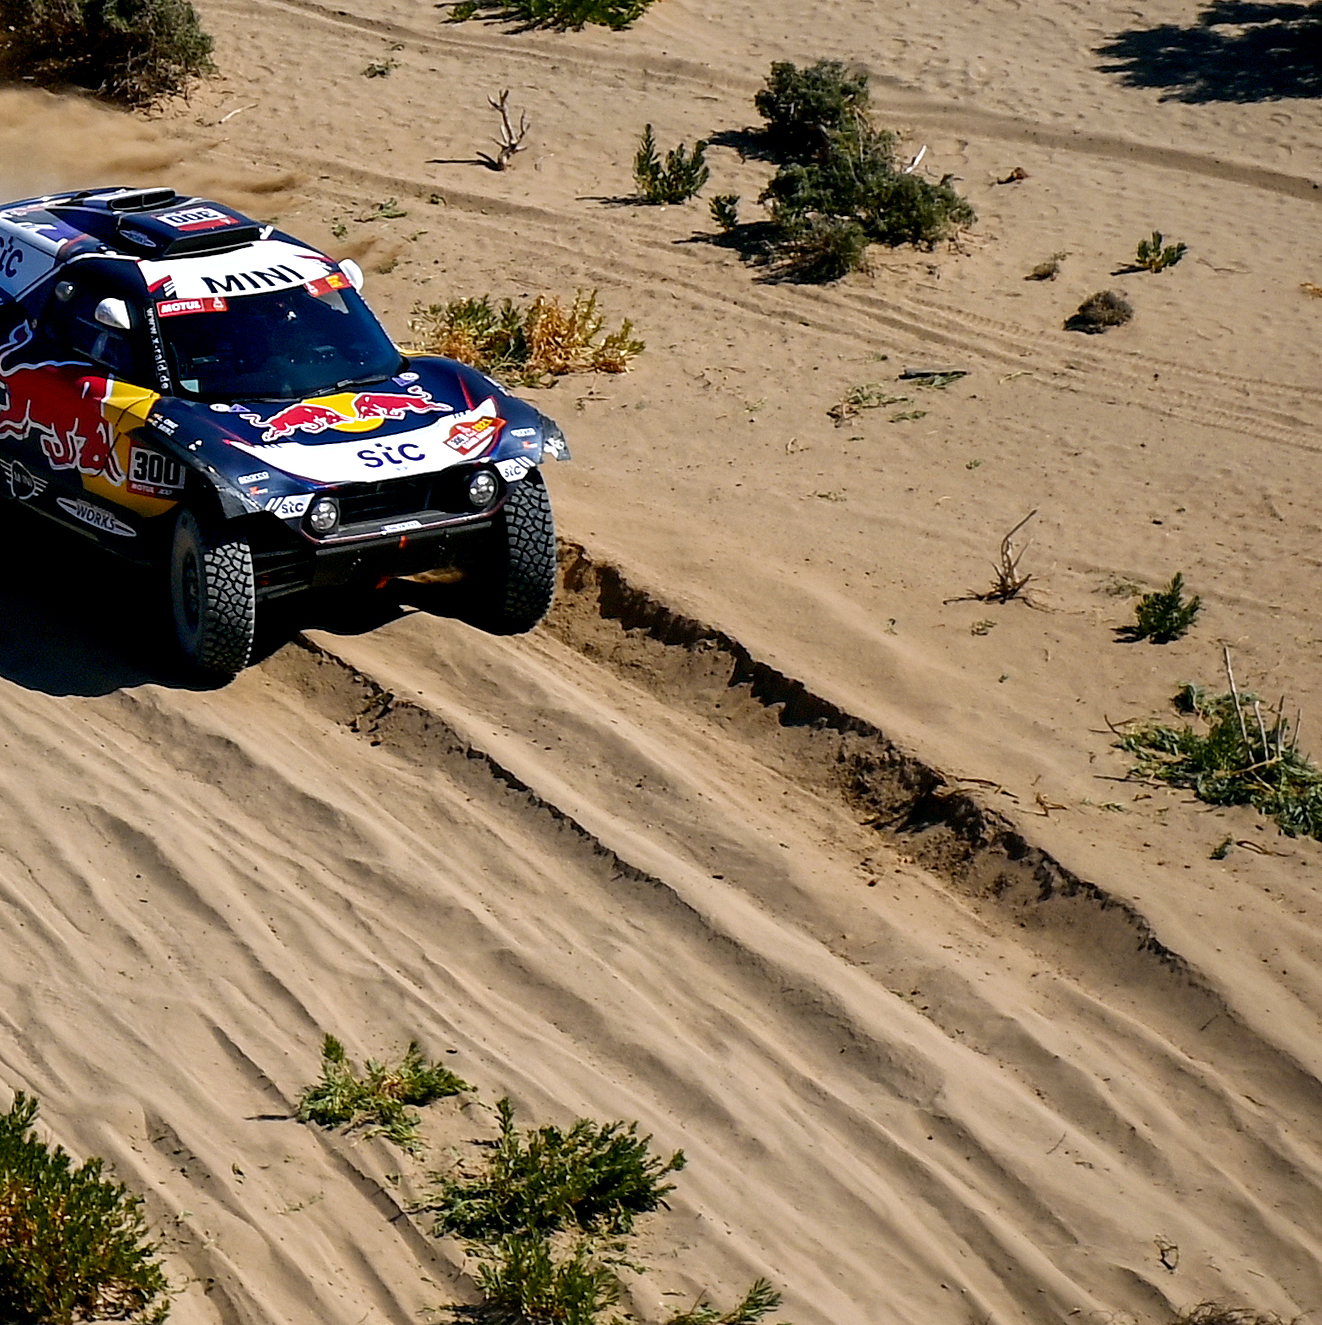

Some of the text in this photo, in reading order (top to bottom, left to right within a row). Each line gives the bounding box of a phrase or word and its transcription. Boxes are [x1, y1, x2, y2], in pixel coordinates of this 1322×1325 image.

[200, 264, 305, 293] MINI
[161, 300, 201, 314] MOTUL
[133, 451, 182, 486] 300
[76, 504, 115, 530] WORKS
